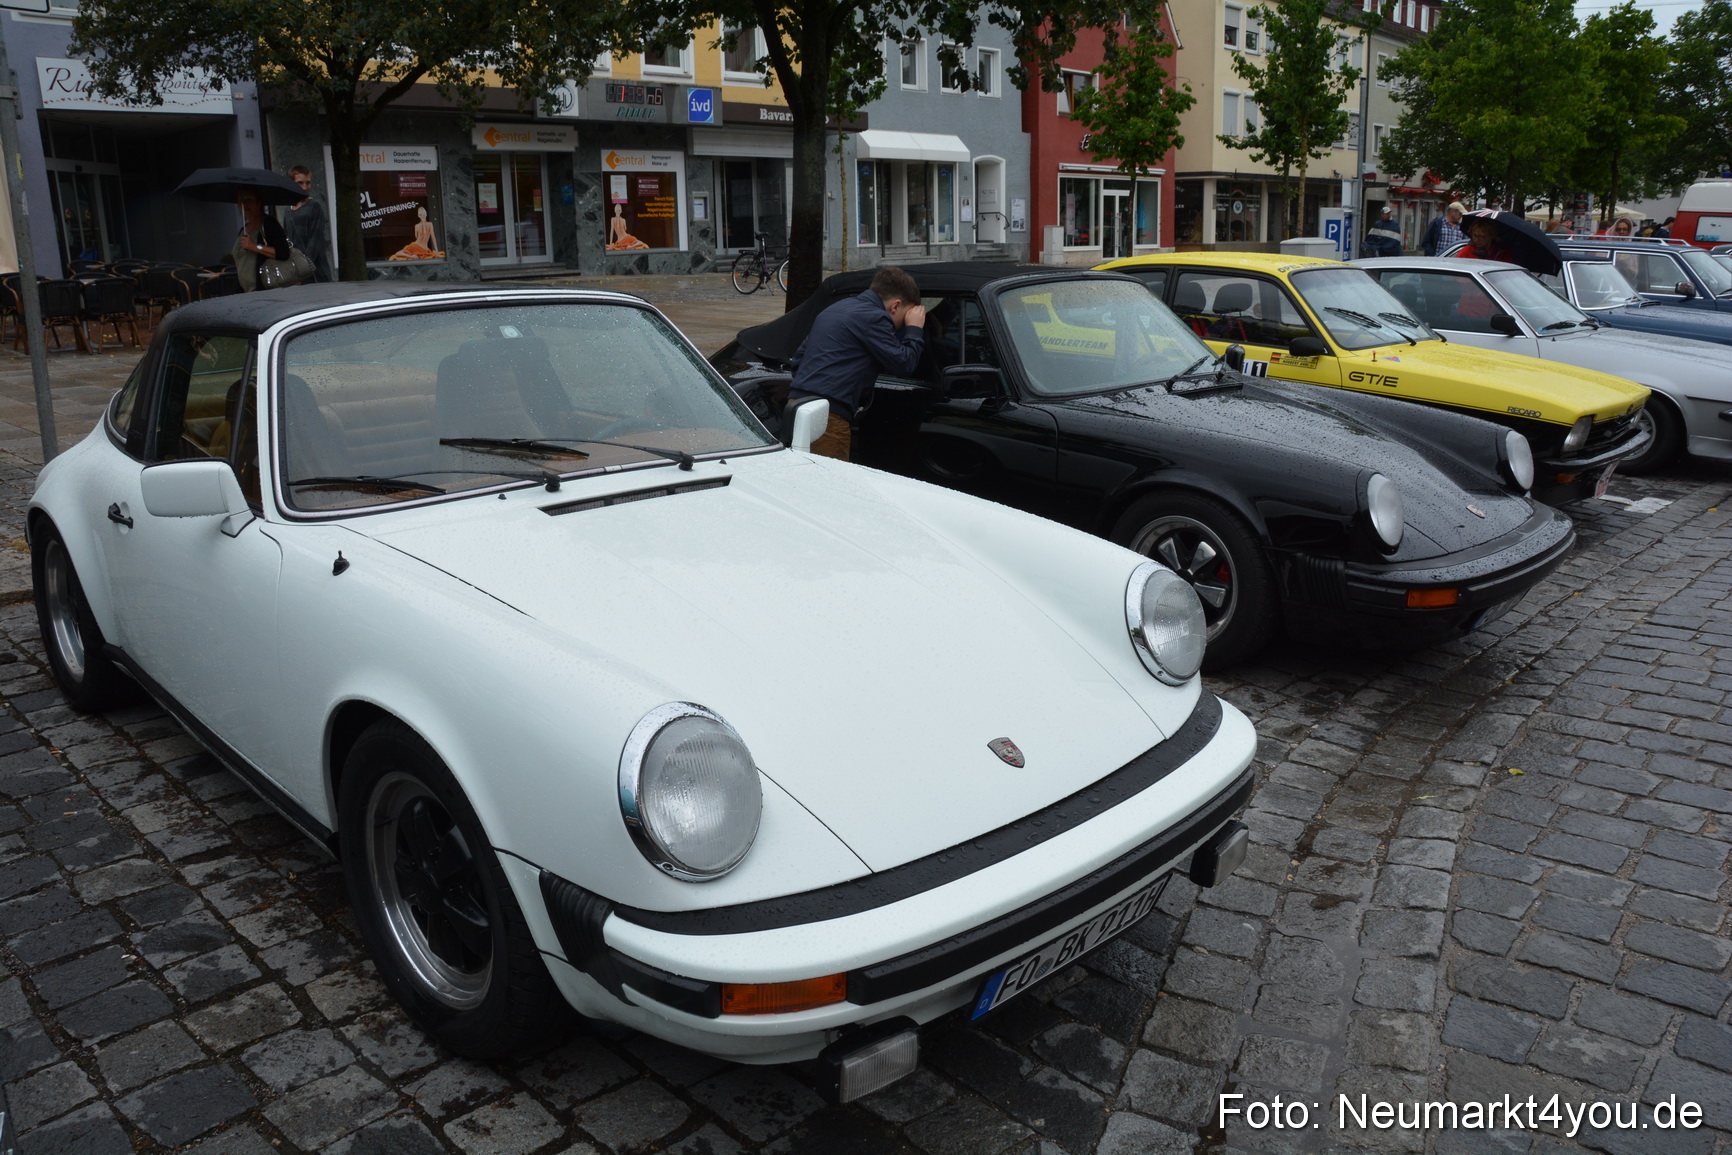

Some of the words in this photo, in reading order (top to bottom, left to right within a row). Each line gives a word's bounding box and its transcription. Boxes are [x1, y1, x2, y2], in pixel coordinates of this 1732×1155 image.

[690, 98, 711, 112] ivd
[493, 130, 531, 144] Central
[360, 152, 385, 163] ntral
[613, 155, 646, 167] Central
[360, 201, 419, 219] AARENTFERNUNGS-
[1328, 223, 1339, 239] P
[1348, 371, 1399, 388] GT/E
[1506, 405, 1542, 418] RECARO
[995, 954, 1041, 1003] FO
[1053, 919, 1098, 966] BK
[979, 999, 988, 1010] D
